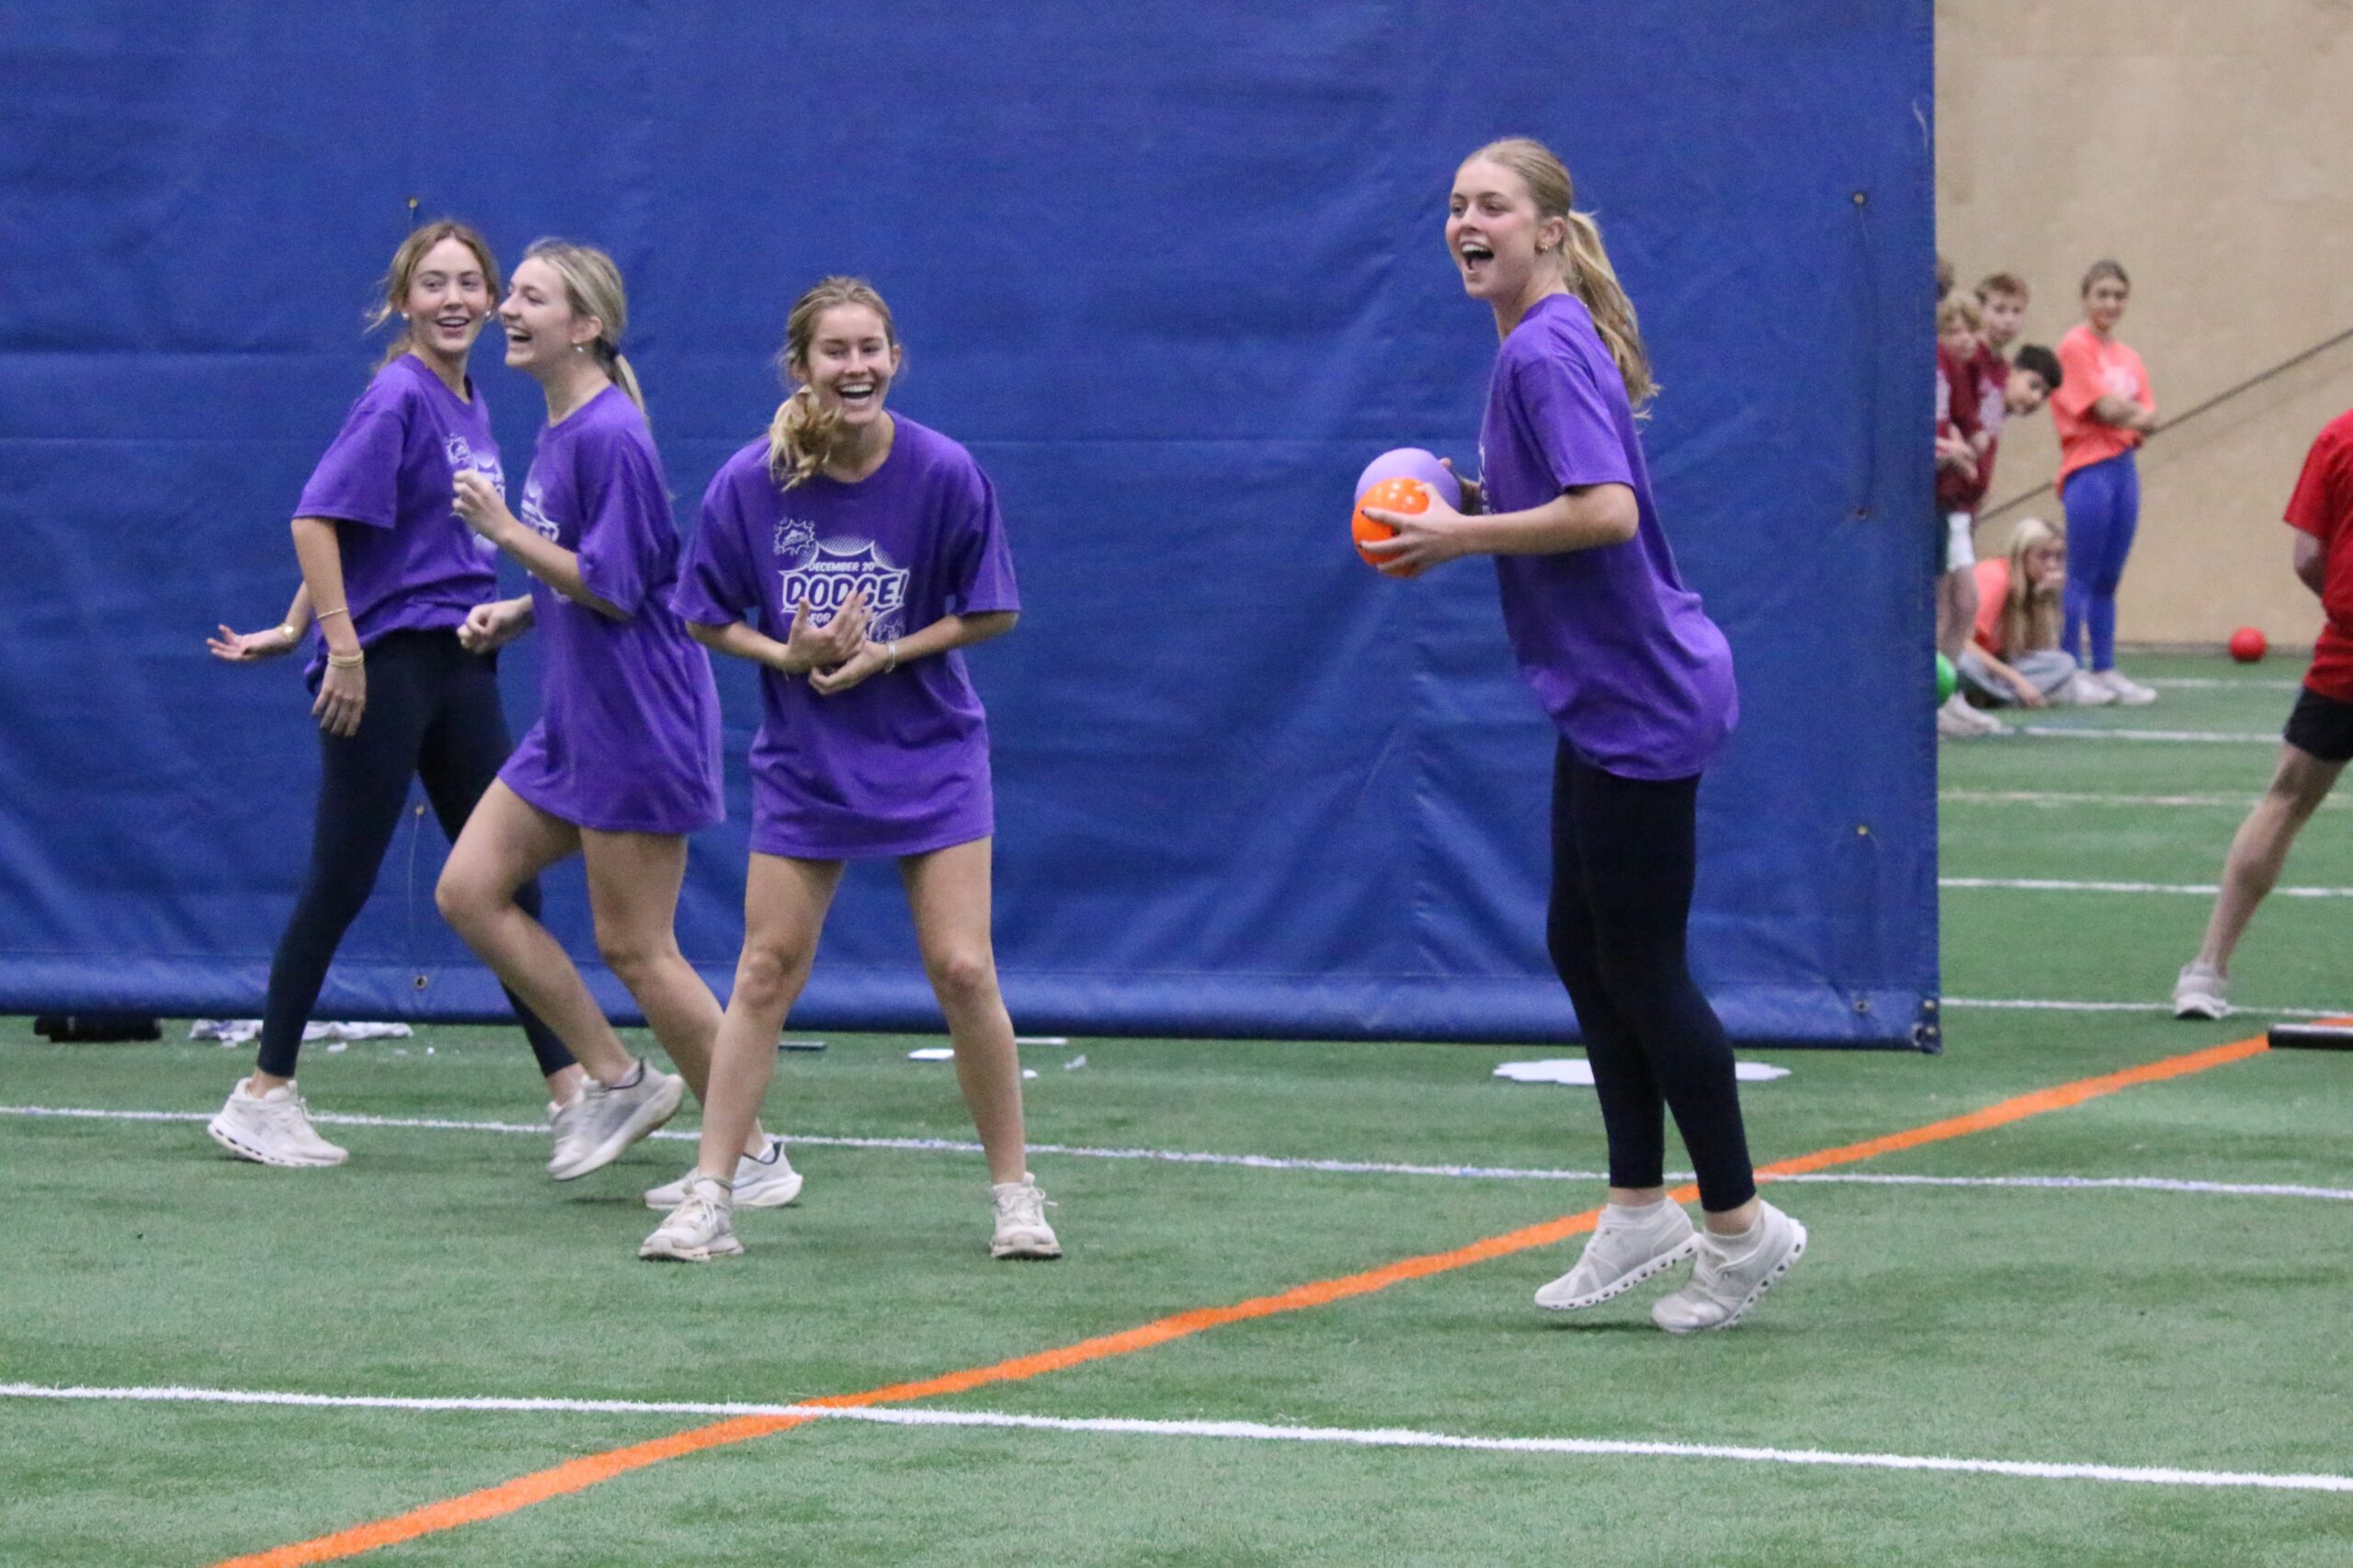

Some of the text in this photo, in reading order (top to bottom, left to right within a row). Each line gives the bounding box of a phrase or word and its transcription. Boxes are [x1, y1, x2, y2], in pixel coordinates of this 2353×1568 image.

[808, 562, 875, 572] DECEMBER 20
[810, 613, 831, 624] FOR
